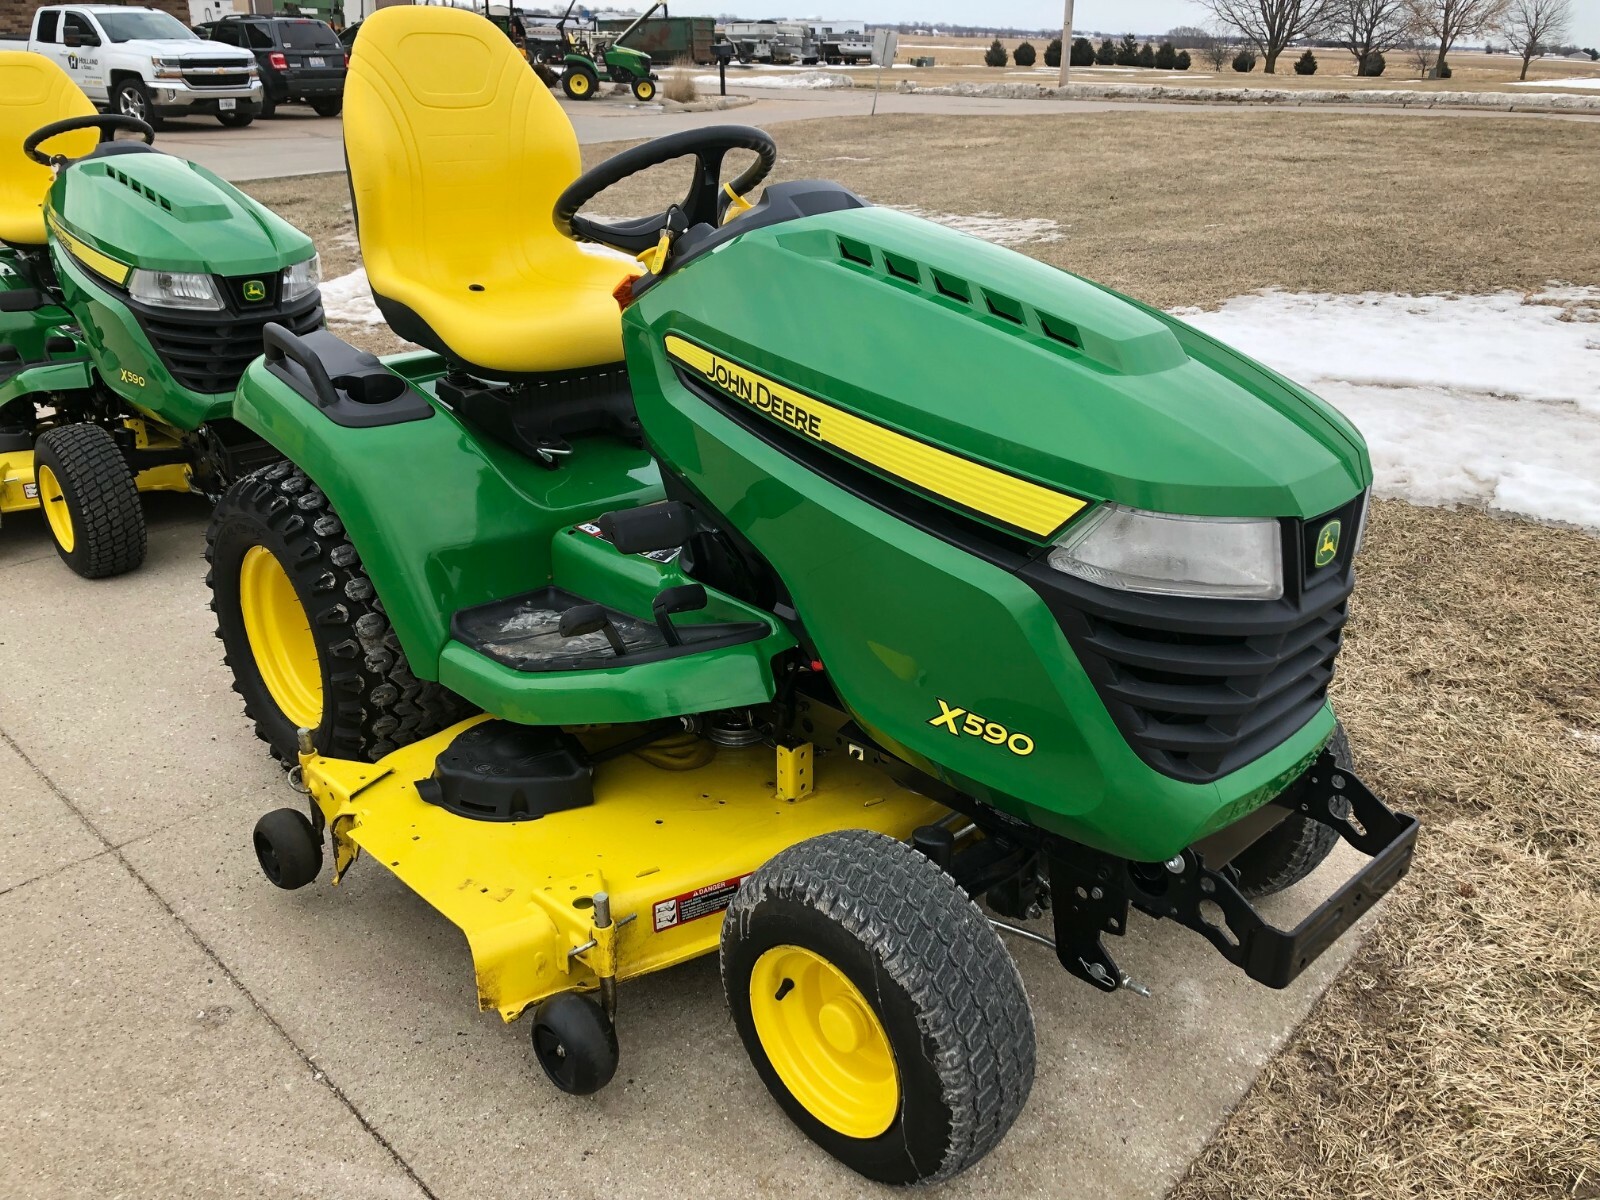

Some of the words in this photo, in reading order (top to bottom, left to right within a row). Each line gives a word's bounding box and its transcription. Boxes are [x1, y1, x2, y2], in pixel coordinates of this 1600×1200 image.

[120, 367, 146, 387] X590
[706, 357, 752, 402] JOHN
[756, 381, 822, 439] DEERE
[925, 697, 1035, 756] X590
[698, 881, 726, 896] DANGER
